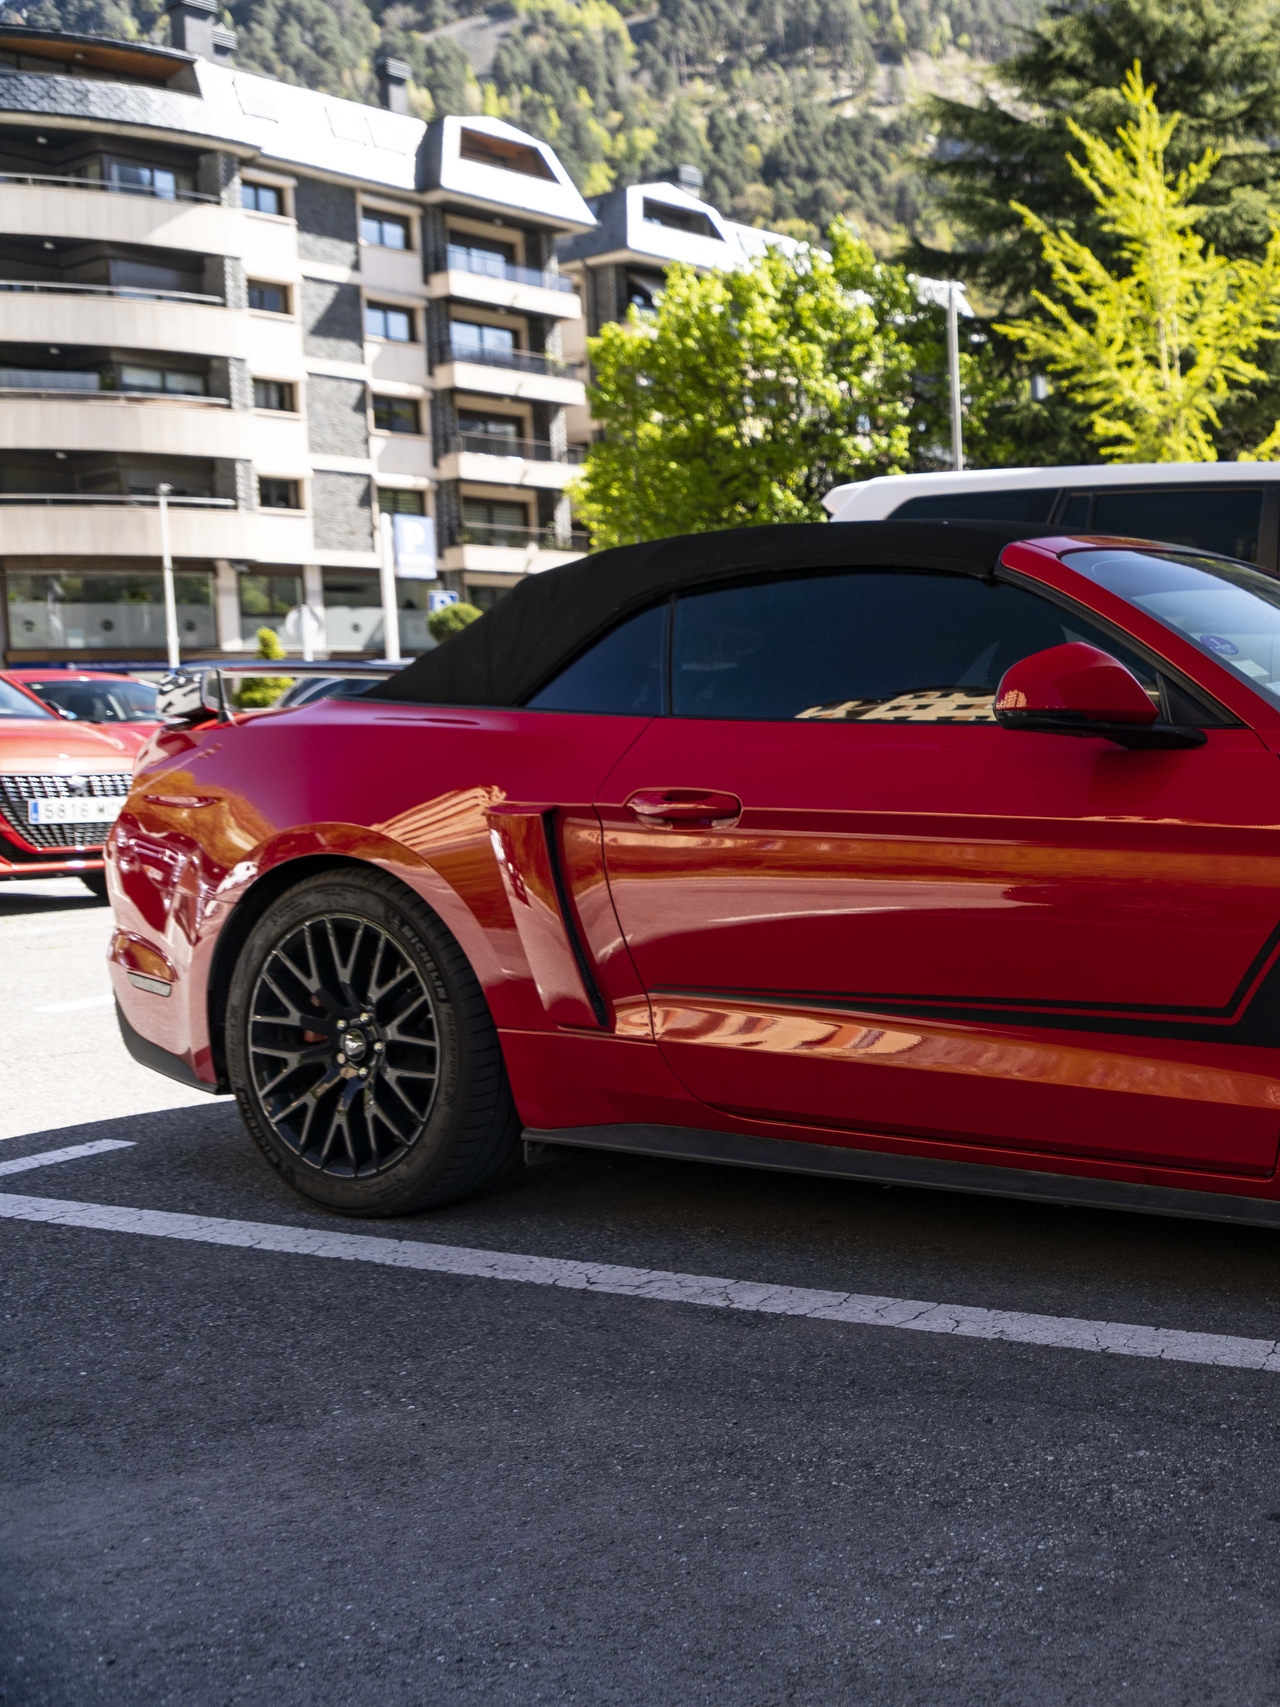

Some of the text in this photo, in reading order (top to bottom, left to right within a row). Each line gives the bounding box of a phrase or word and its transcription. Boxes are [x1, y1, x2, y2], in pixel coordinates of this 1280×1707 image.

[403, 521, 426, 554] P
[44, 803, 89, 819] 5816
[401, 925, 448, 1000] MICHELIN
[446, 1012, 458, 1082] PILOT SPORT
[238, 1091, 279, 1163] MICHELIN
